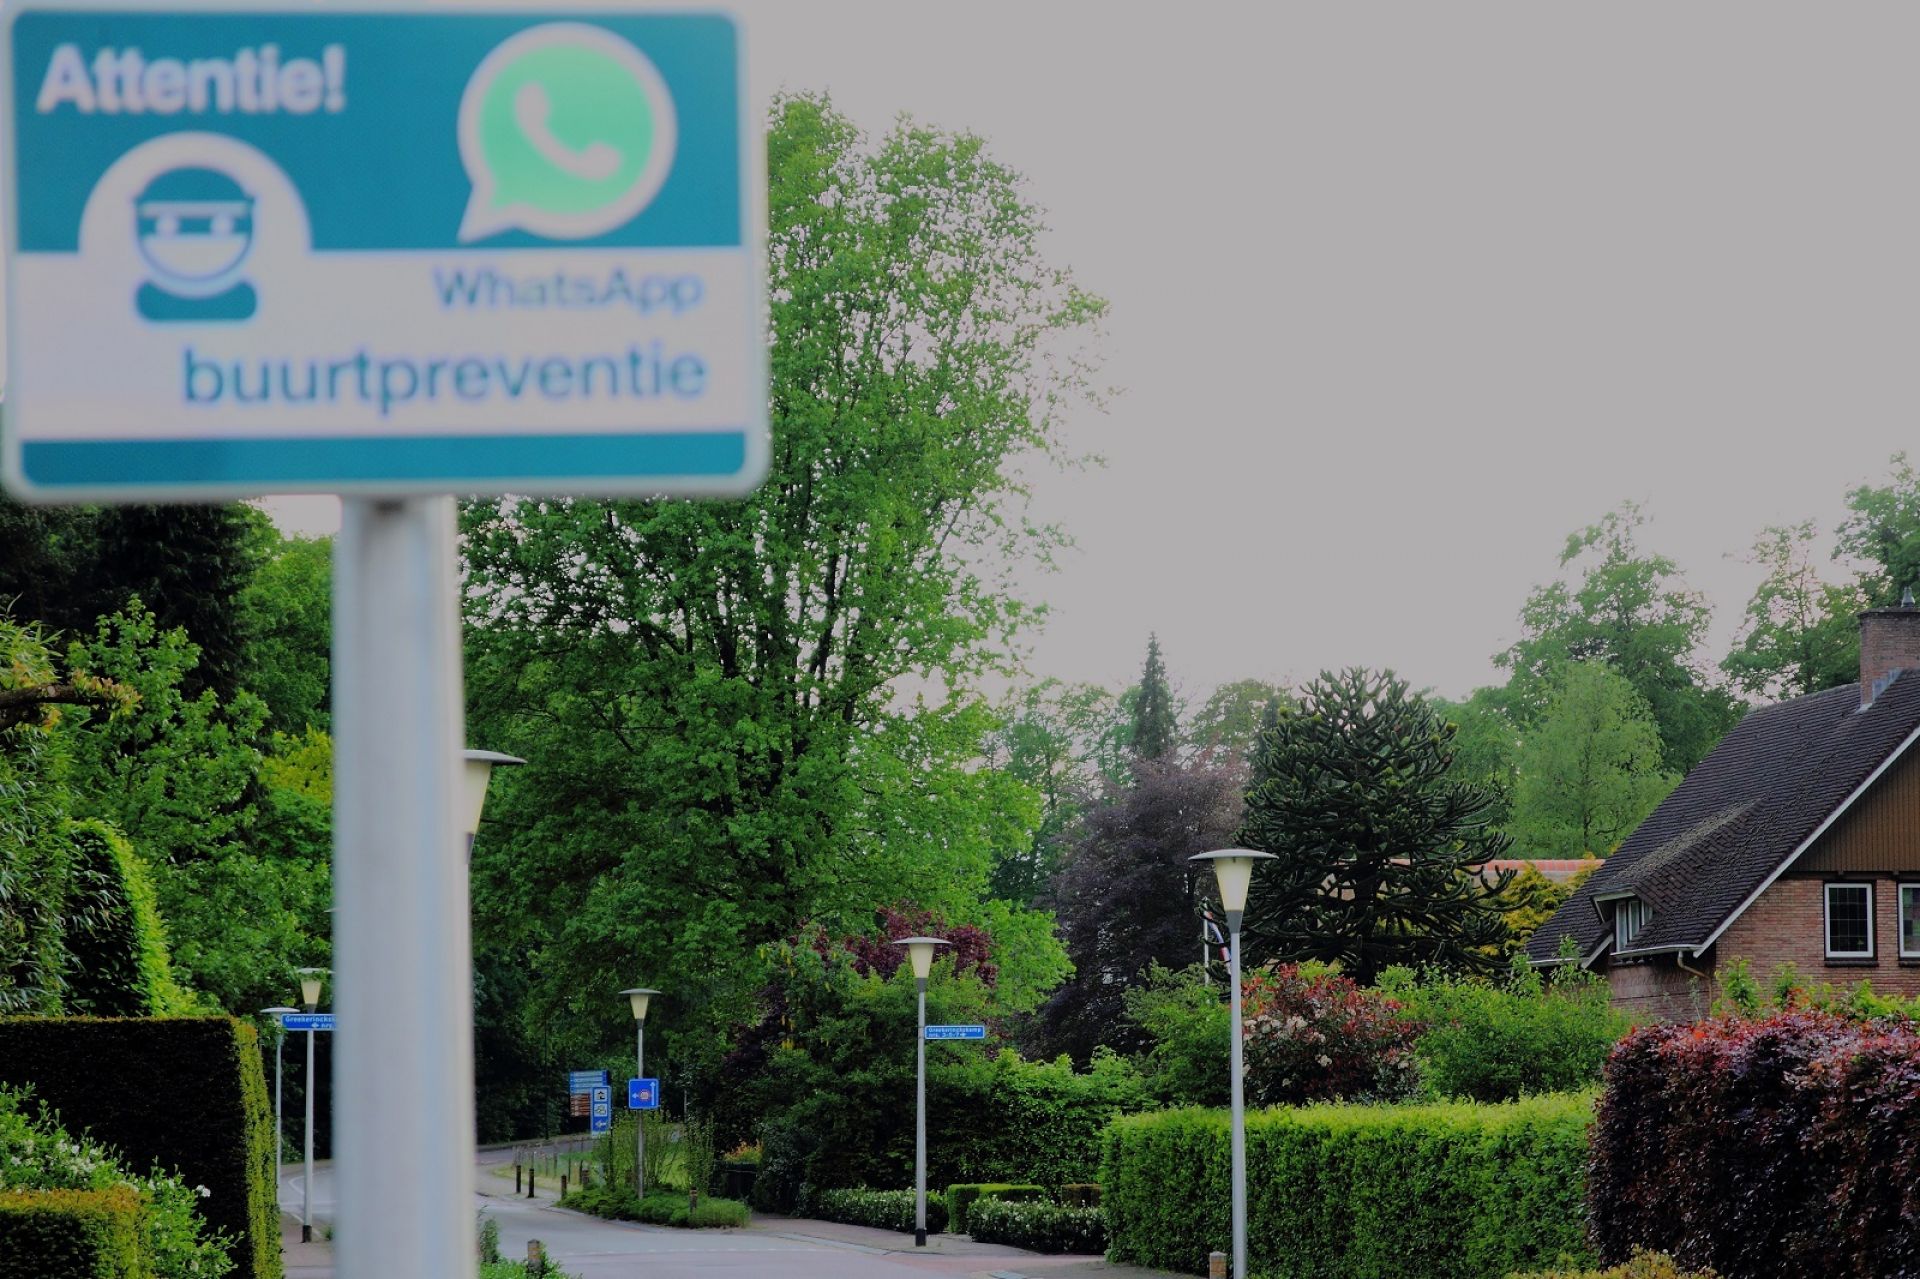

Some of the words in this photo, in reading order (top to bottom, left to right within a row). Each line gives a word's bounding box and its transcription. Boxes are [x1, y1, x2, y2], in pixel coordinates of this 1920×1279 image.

[37, 44, 346, 114] Attentie!
[433, 266, 705, 313] WhatsApp
[184, 347, 708, 415] buurtpreventie
